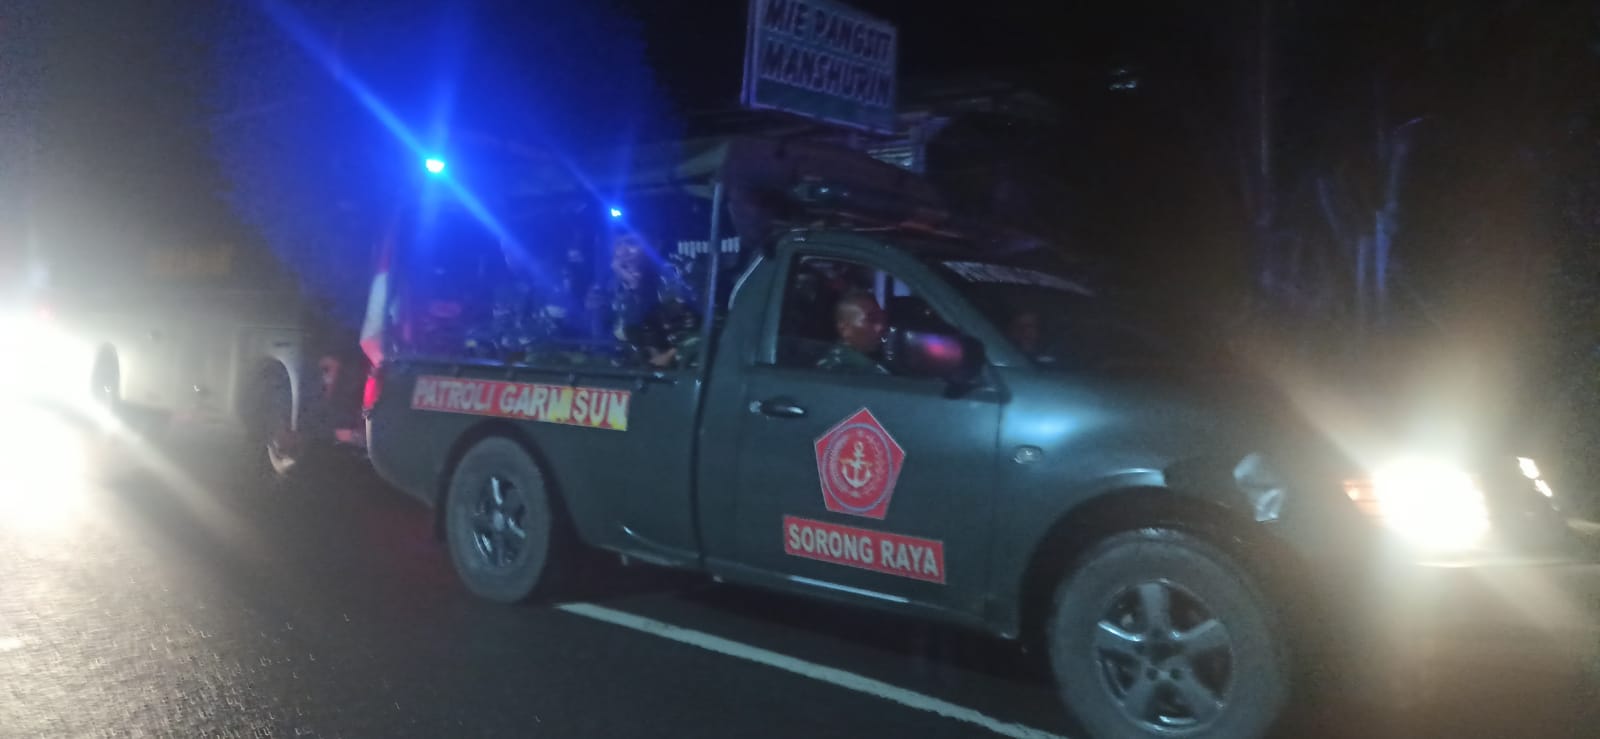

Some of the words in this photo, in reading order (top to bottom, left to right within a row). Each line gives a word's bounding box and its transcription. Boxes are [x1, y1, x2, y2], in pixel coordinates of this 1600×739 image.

[764, 0, 809, 38] MIE
[813, 8, 893, 64] PANGSIT
[412, 378, 496, 411] PATROLI
[788, 523, 874, 565] SORONG
[880, 539, 940, 578] RAYA
